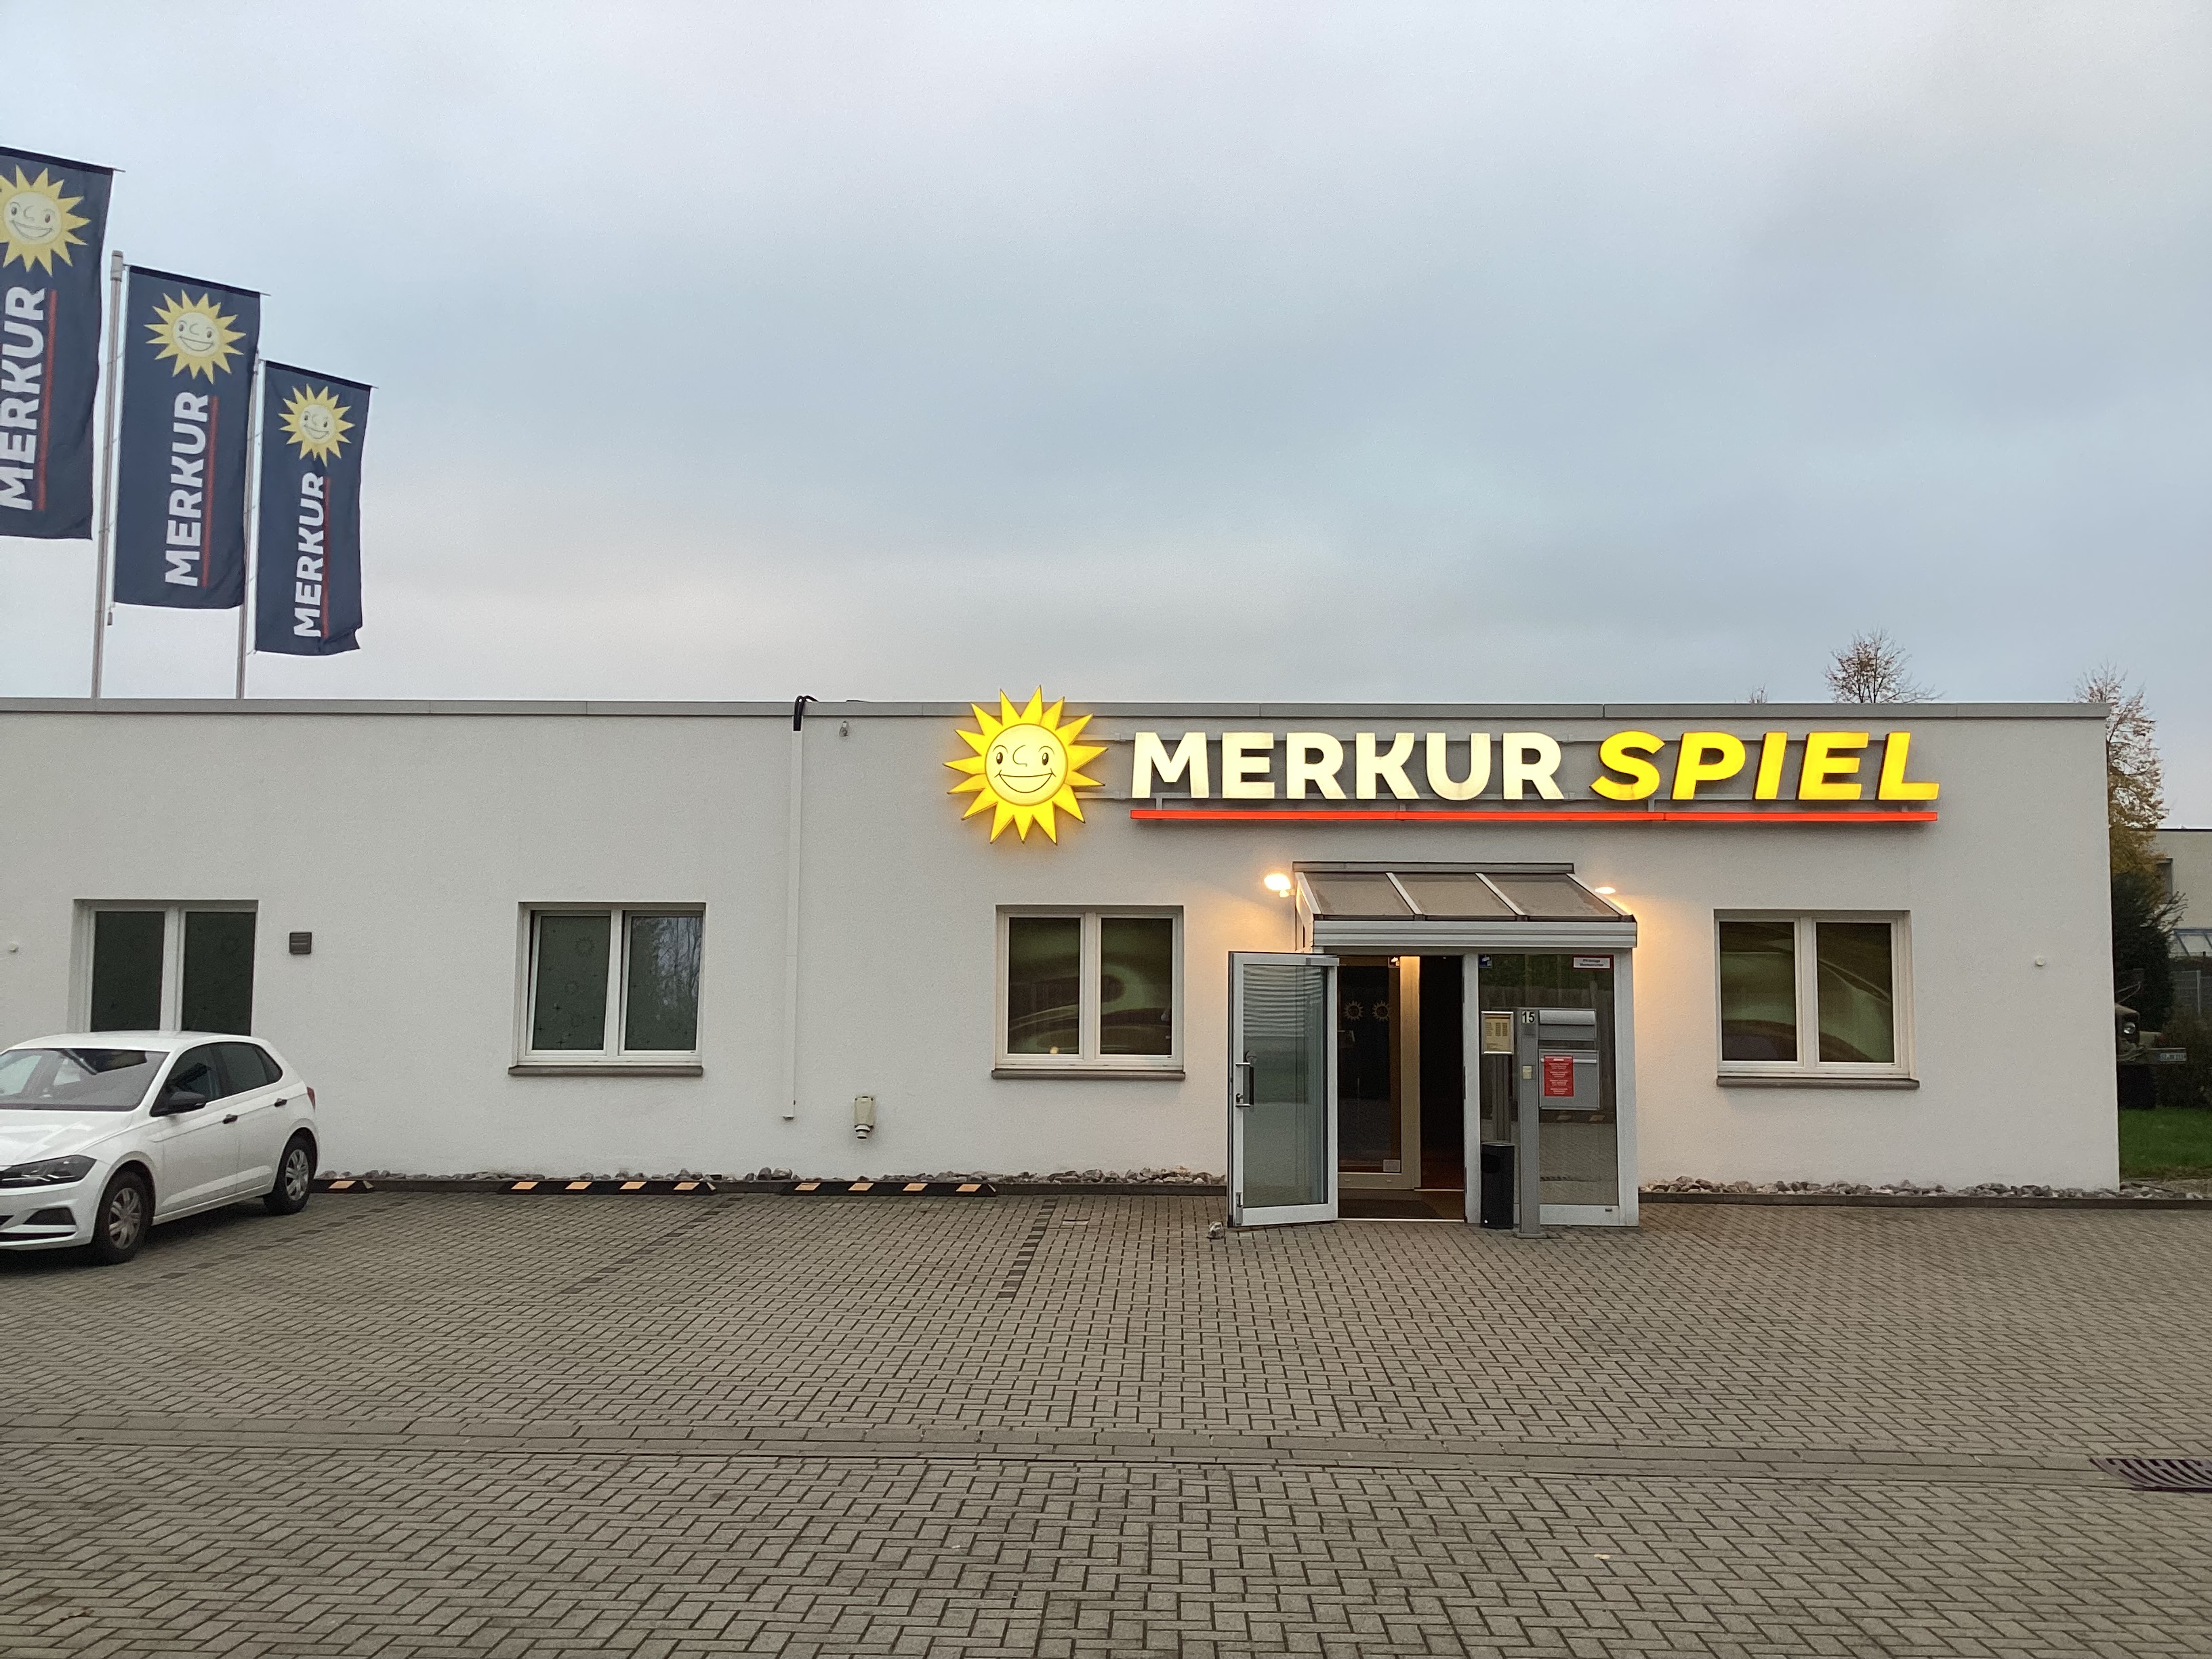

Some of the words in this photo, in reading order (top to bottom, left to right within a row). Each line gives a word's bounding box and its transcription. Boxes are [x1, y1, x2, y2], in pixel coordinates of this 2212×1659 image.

[0, 286, 45, 510] MERKUR
[164, 390, 209, 587] MERKUR
[293, 471, 325, 638] MERKUR
[1130, 731, 1565, 800] MERKUR
[1589, 730, 1940, 802] SPIEL
[1522, 1011, 1535, 1023] 15
